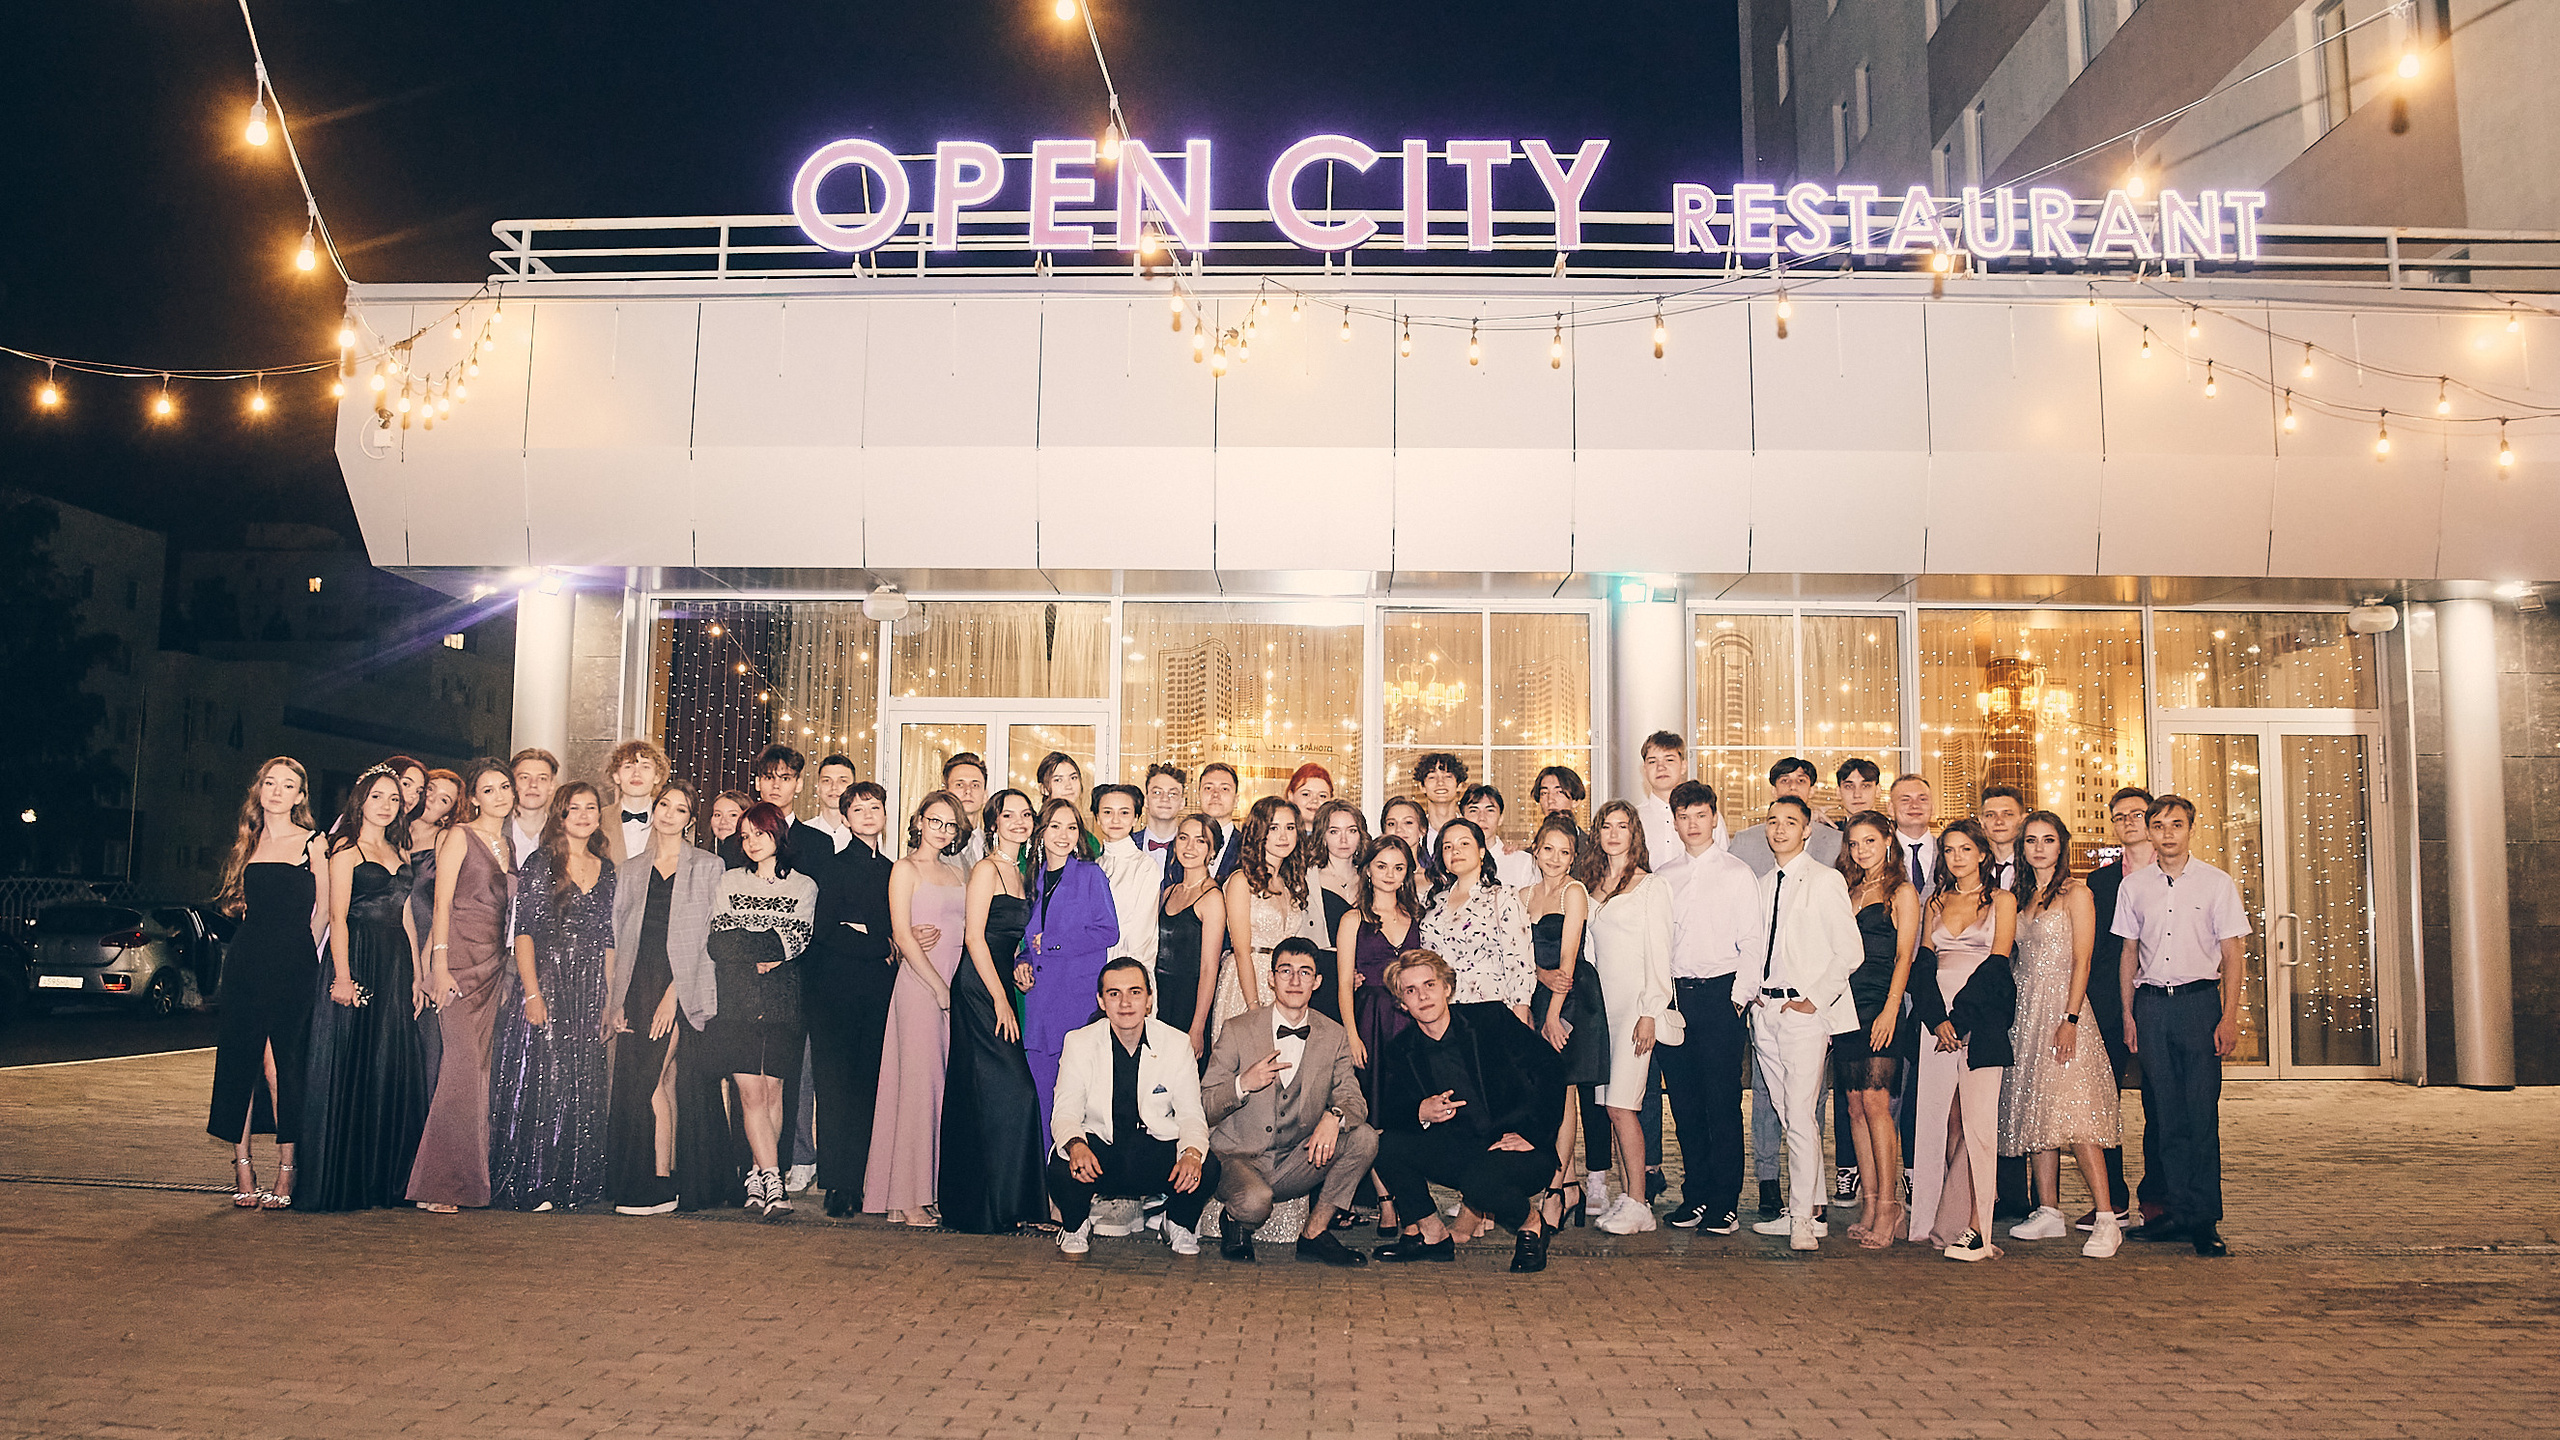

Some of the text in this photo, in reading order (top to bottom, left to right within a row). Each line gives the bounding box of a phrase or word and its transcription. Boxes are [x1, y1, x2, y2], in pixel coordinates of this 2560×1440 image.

[791, 133, 2267, 262] OPEN CITY RESTAURANT
